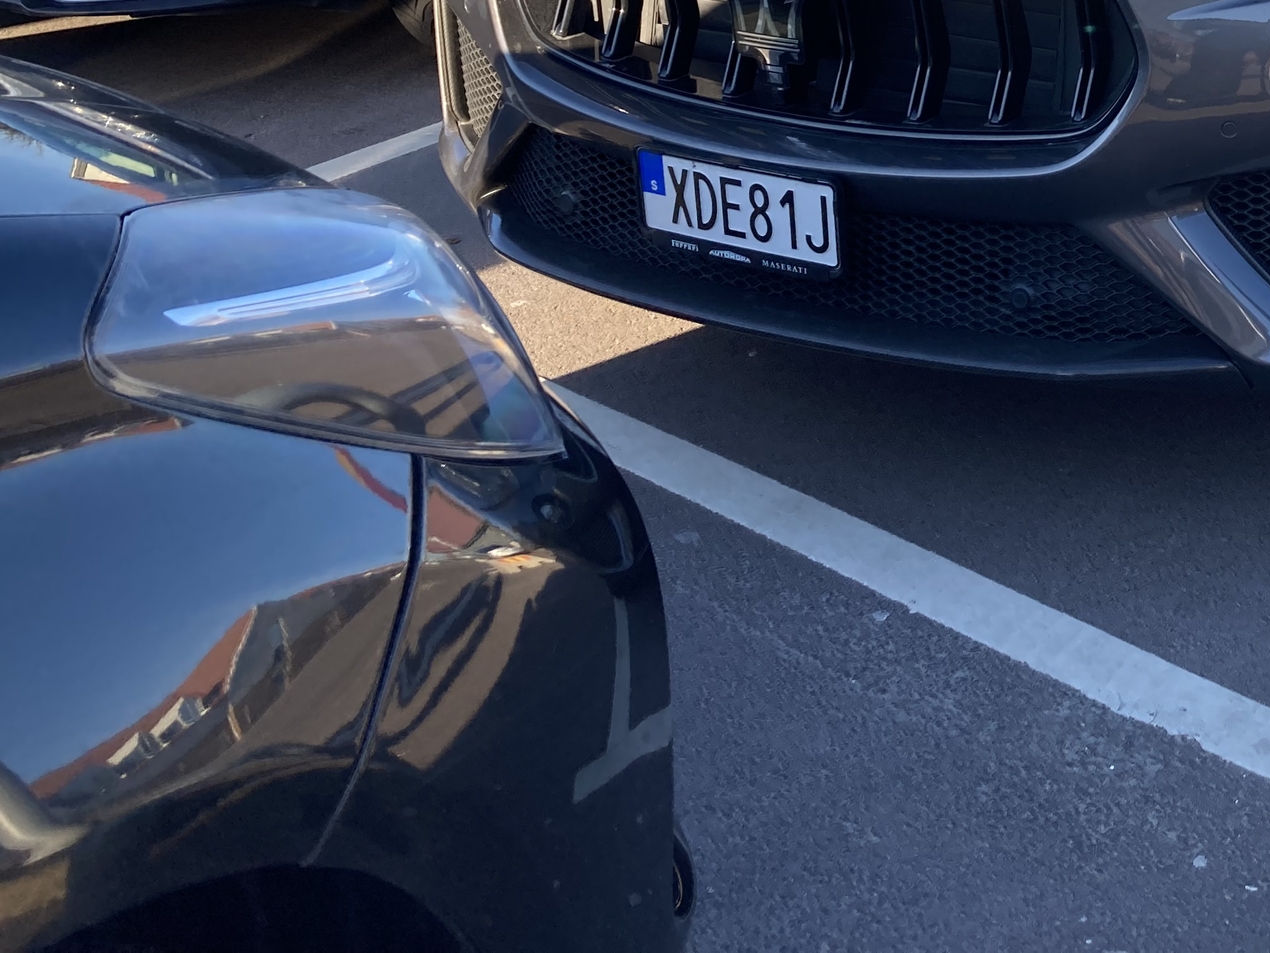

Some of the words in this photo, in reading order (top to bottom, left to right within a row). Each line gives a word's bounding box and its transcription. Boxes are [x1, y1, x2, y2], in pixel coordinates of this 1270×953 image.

[650, 179, 658, 191] S
[668, 166, 829, 254] XDE81J
[762, 259, 808, 275] MASERATI
